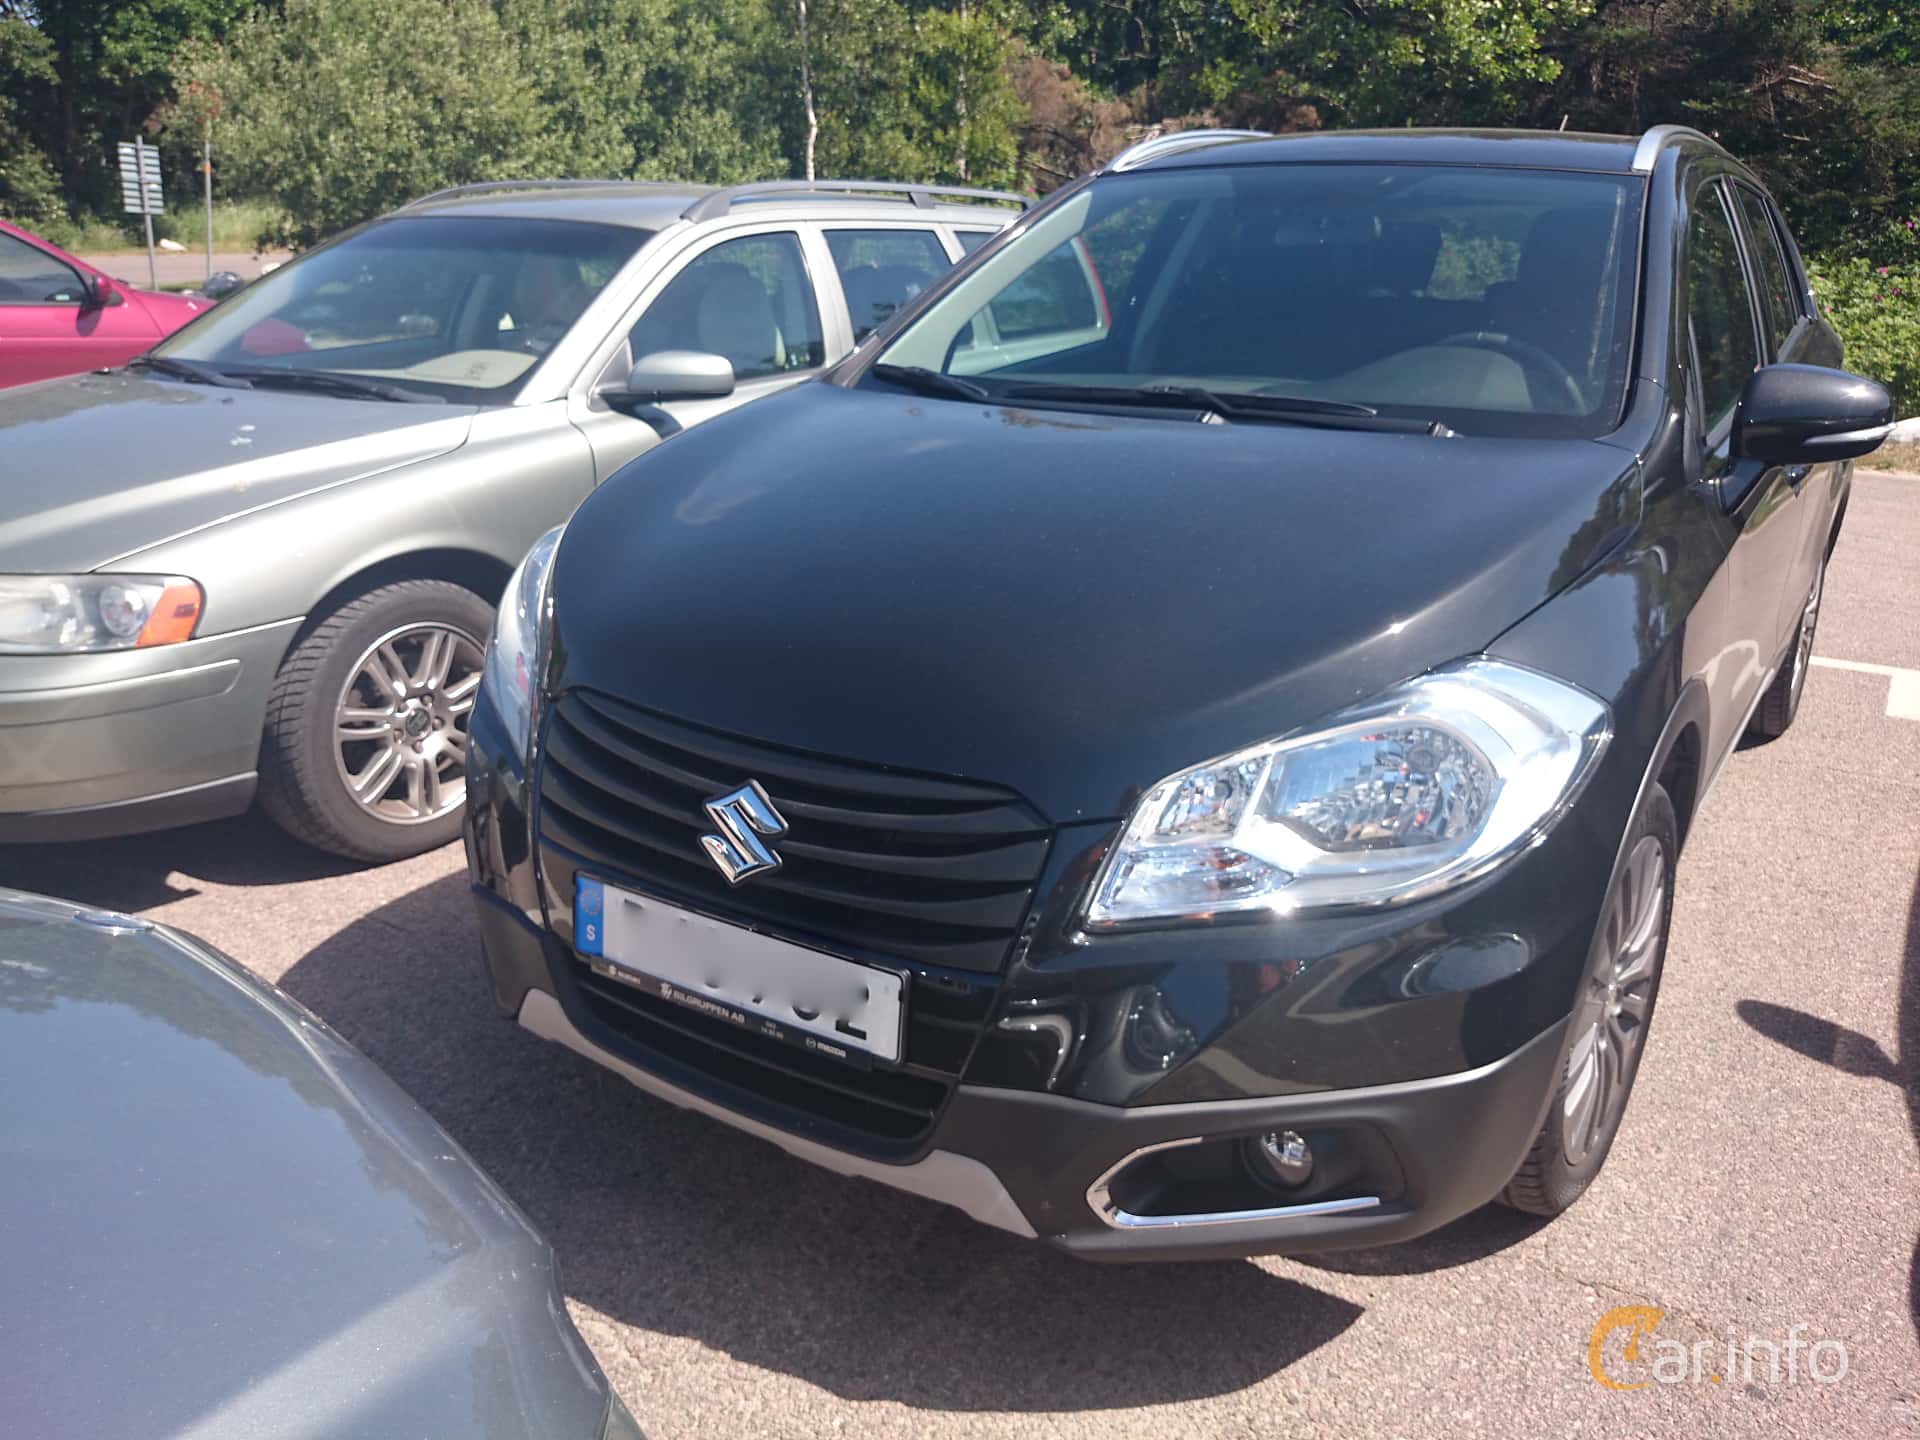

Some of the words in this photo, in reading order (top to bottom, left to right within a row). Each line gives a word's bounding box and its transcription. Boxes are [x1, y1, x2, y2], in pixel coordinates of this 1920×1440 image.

[586, 924, 596, 941] S
[673, 990, 730, 1018] BILGRUPPEN
[731, 1011, 745, 1024] AB
